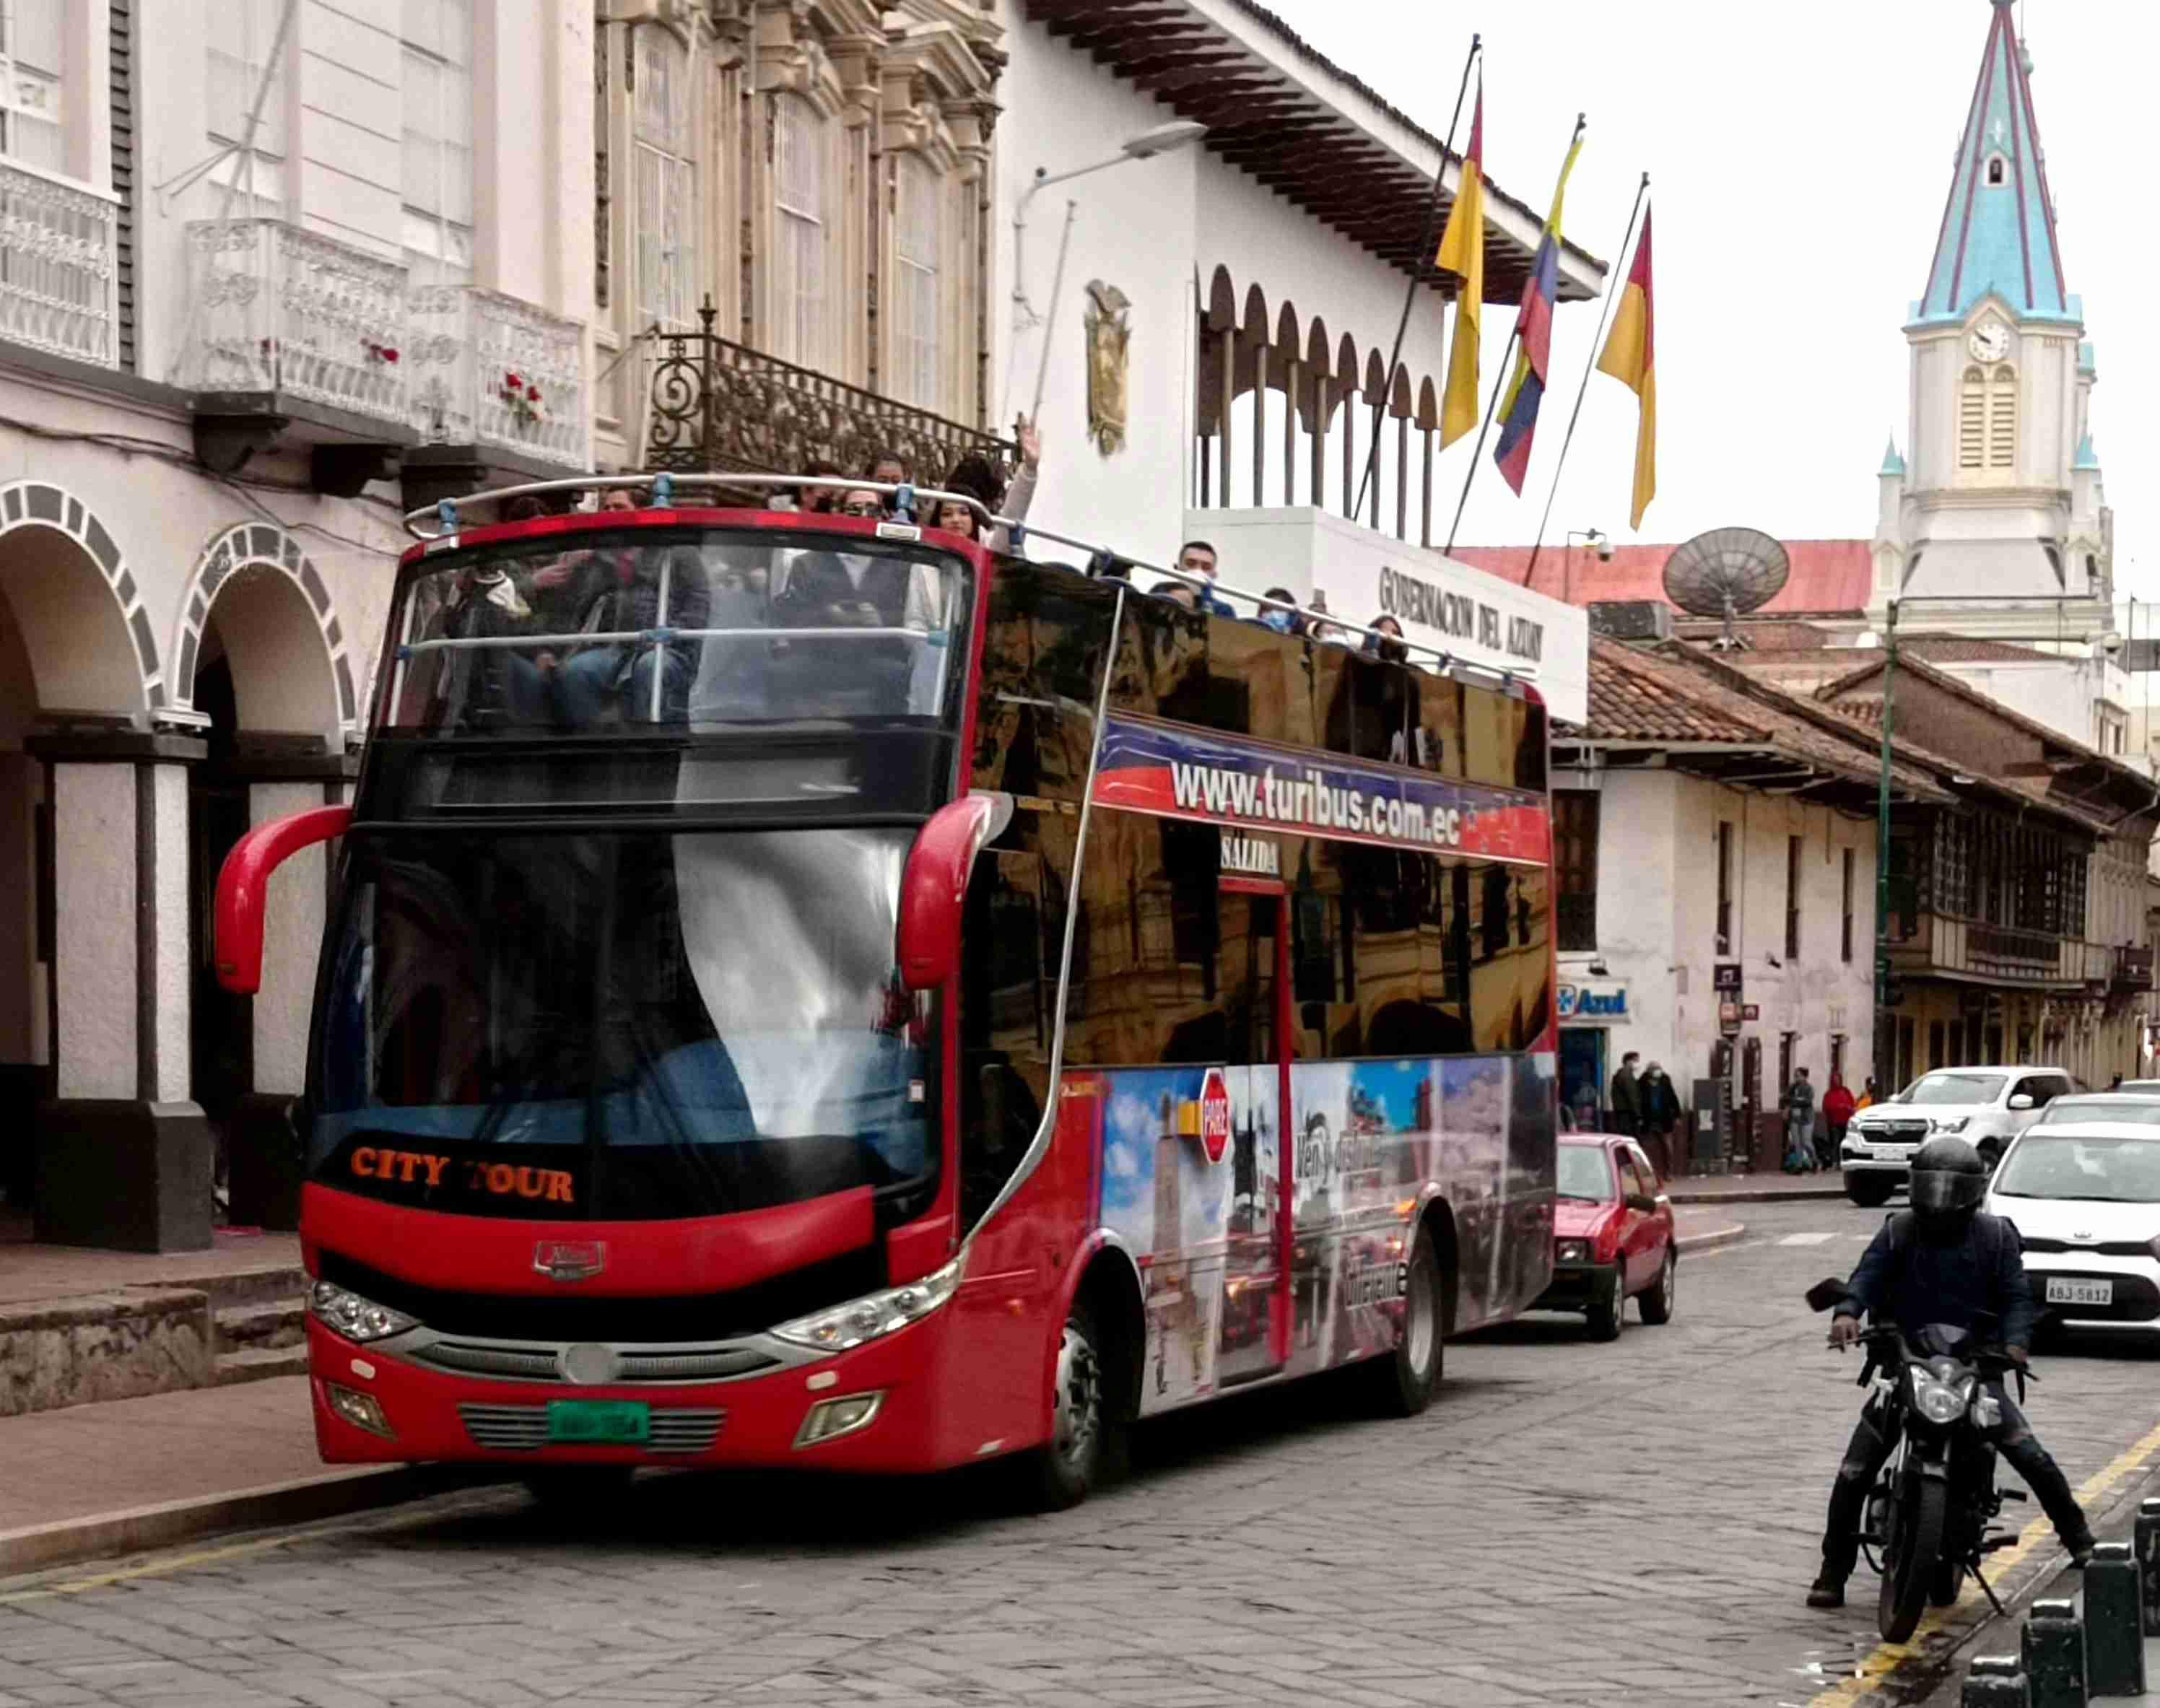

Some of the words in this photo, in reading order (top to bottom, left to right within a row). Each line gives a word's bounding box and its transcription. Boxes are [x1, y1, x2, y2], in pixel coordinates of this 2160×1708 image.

[1478, 603, 1502, 650] DEL
[1171, 762, 1460, 845] www.turibus.com.ec
[1220, 836, 1279, 874] SALIDA
[1578, 989, 1626, 1015] Azul
[1204, 1097, 1227, 1137] PARE
[351, 1146, 450, 1185] CITY
